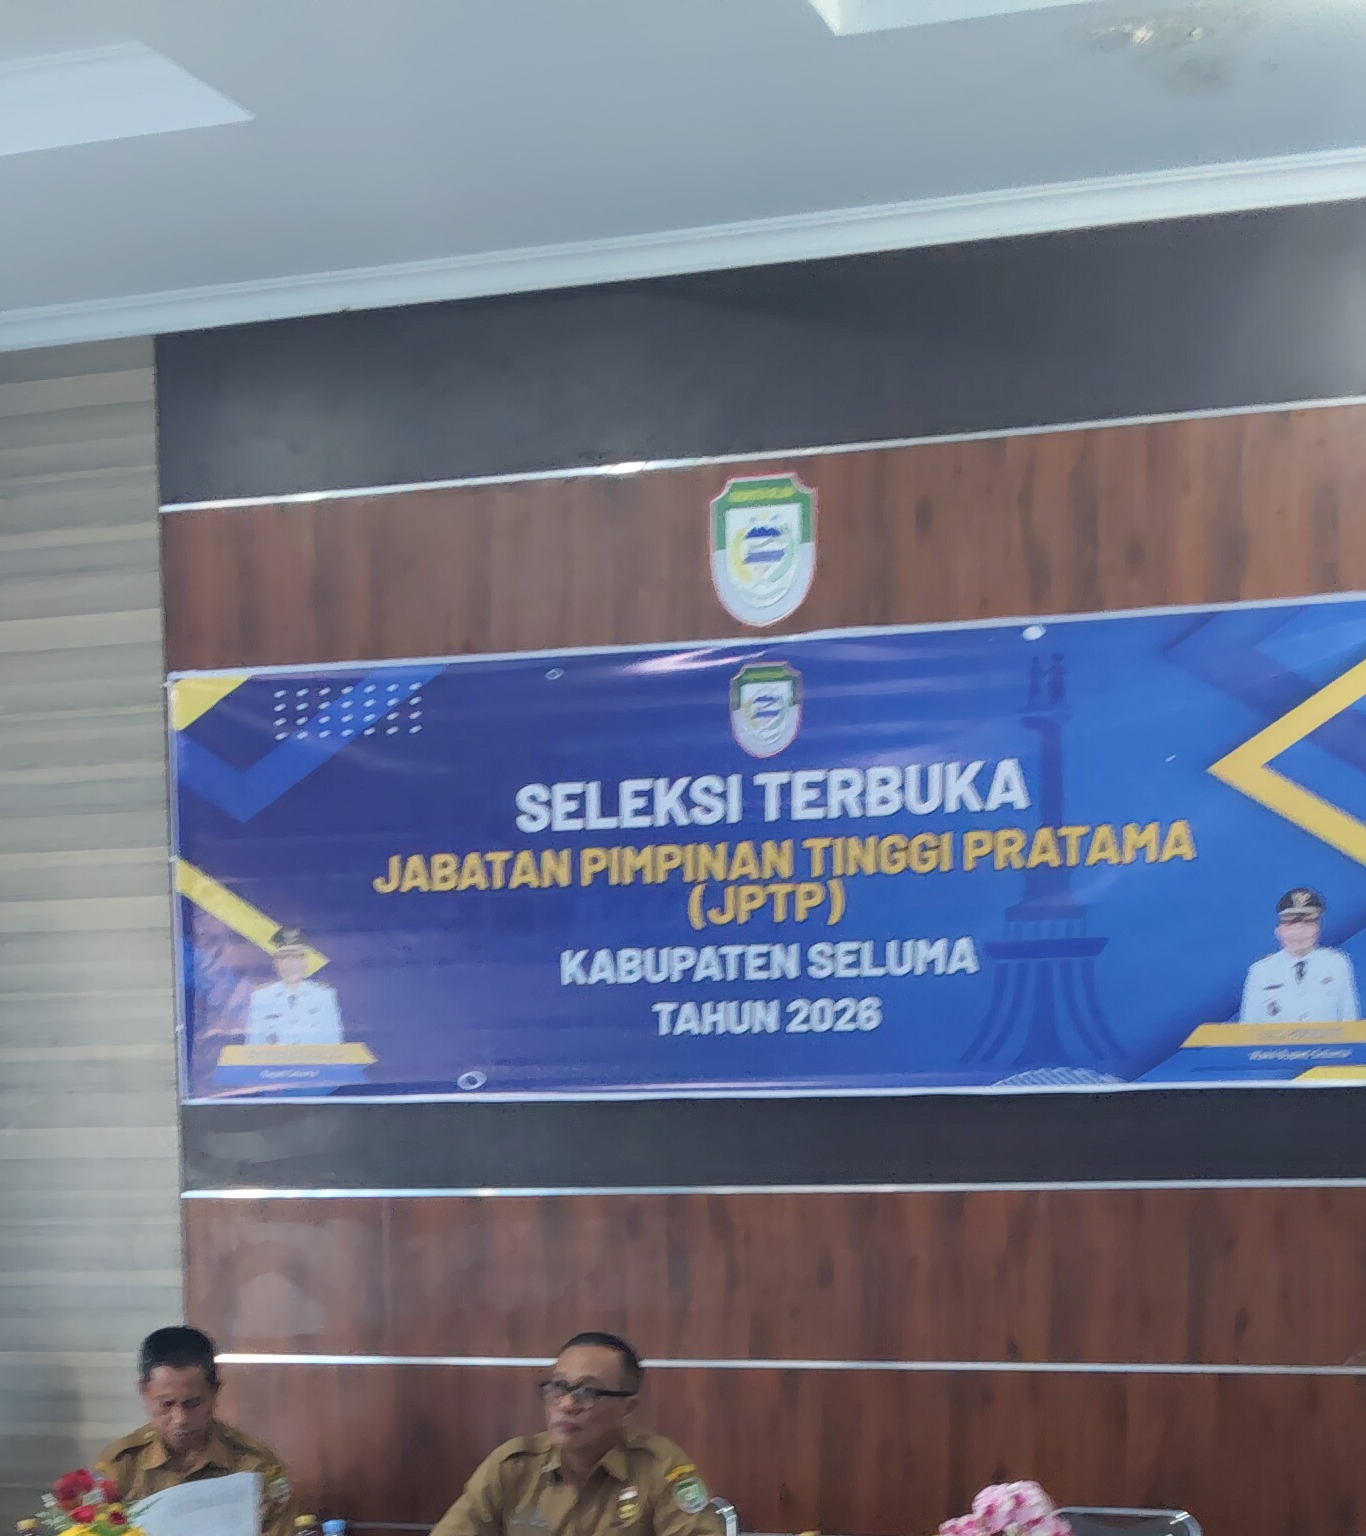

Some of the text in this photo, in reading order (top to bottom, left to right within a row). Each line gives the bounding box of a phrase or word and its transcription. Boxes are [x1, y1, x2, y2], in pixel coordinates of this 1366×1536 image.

[515, 758, 1032, 833] SELEKSI TERBUKA
[372, 820, 1197, 894] JABATAN PIMPINAN TINGGI PRATAMA
[687, 878, 846, 930] (JPTP)
[560, 936, 980, 986] KABUPATEN SELUMA
[651, 996, 884, 1036] TAHUN 2026
